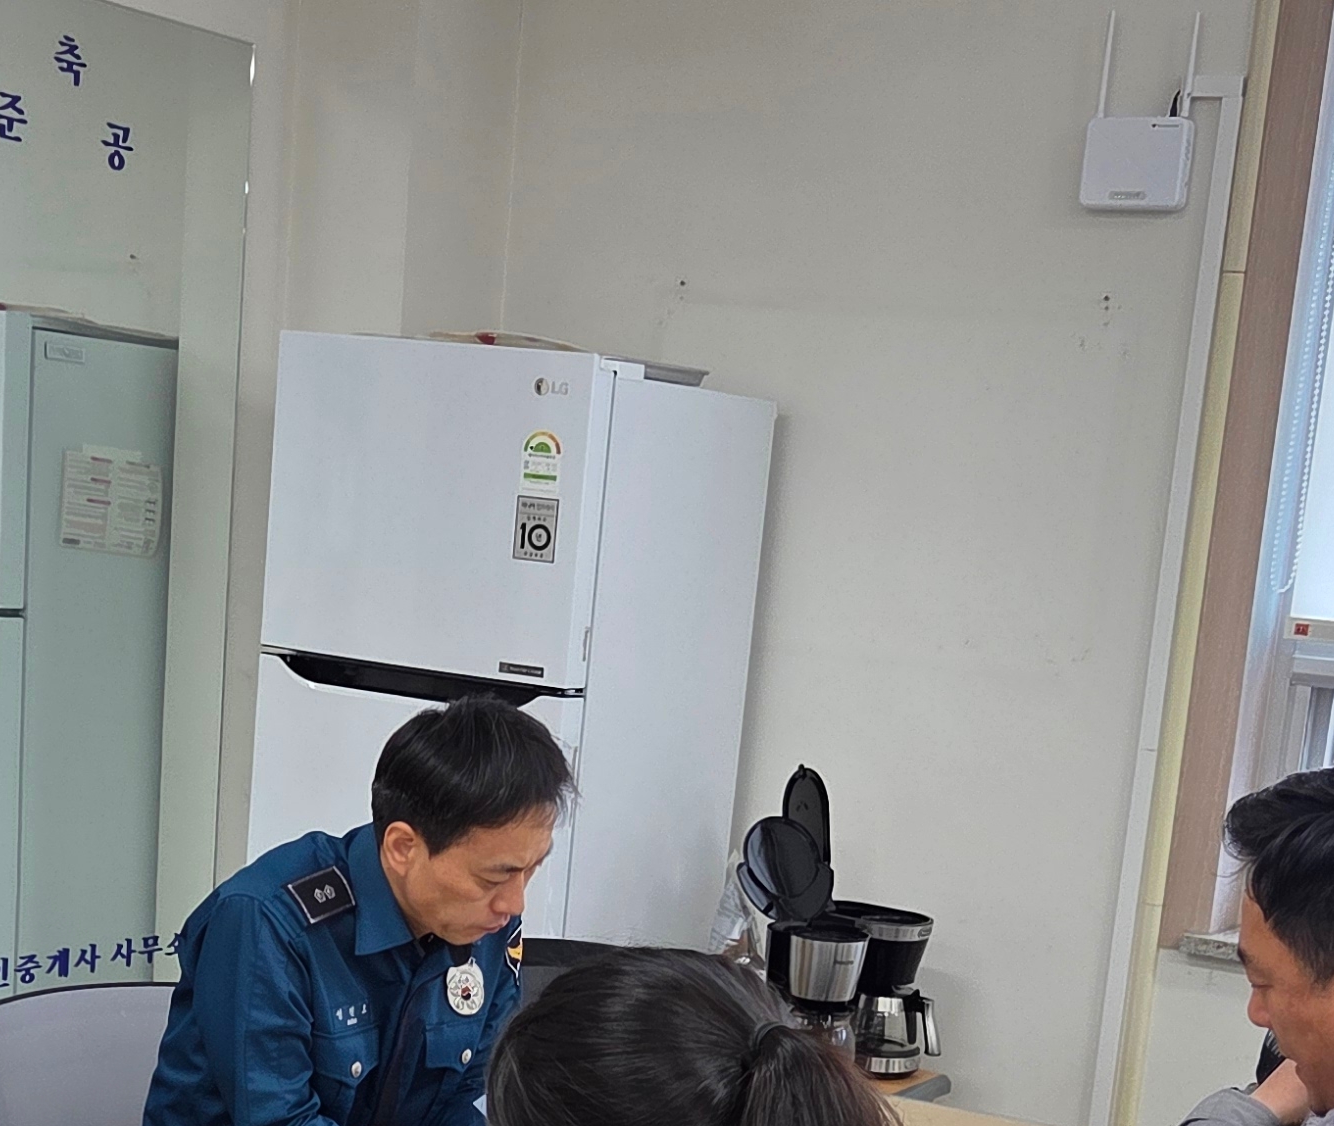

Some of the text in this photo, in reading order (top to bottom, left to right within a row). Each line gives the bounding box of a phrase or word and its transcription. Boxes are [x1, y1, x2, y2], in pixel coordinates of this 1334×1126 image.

[53, 35, 87, 87] 축
[101, 122, 134, 171] 공
[550, 381, 569, 395] LG
[519, 522, 552, 551] 10
